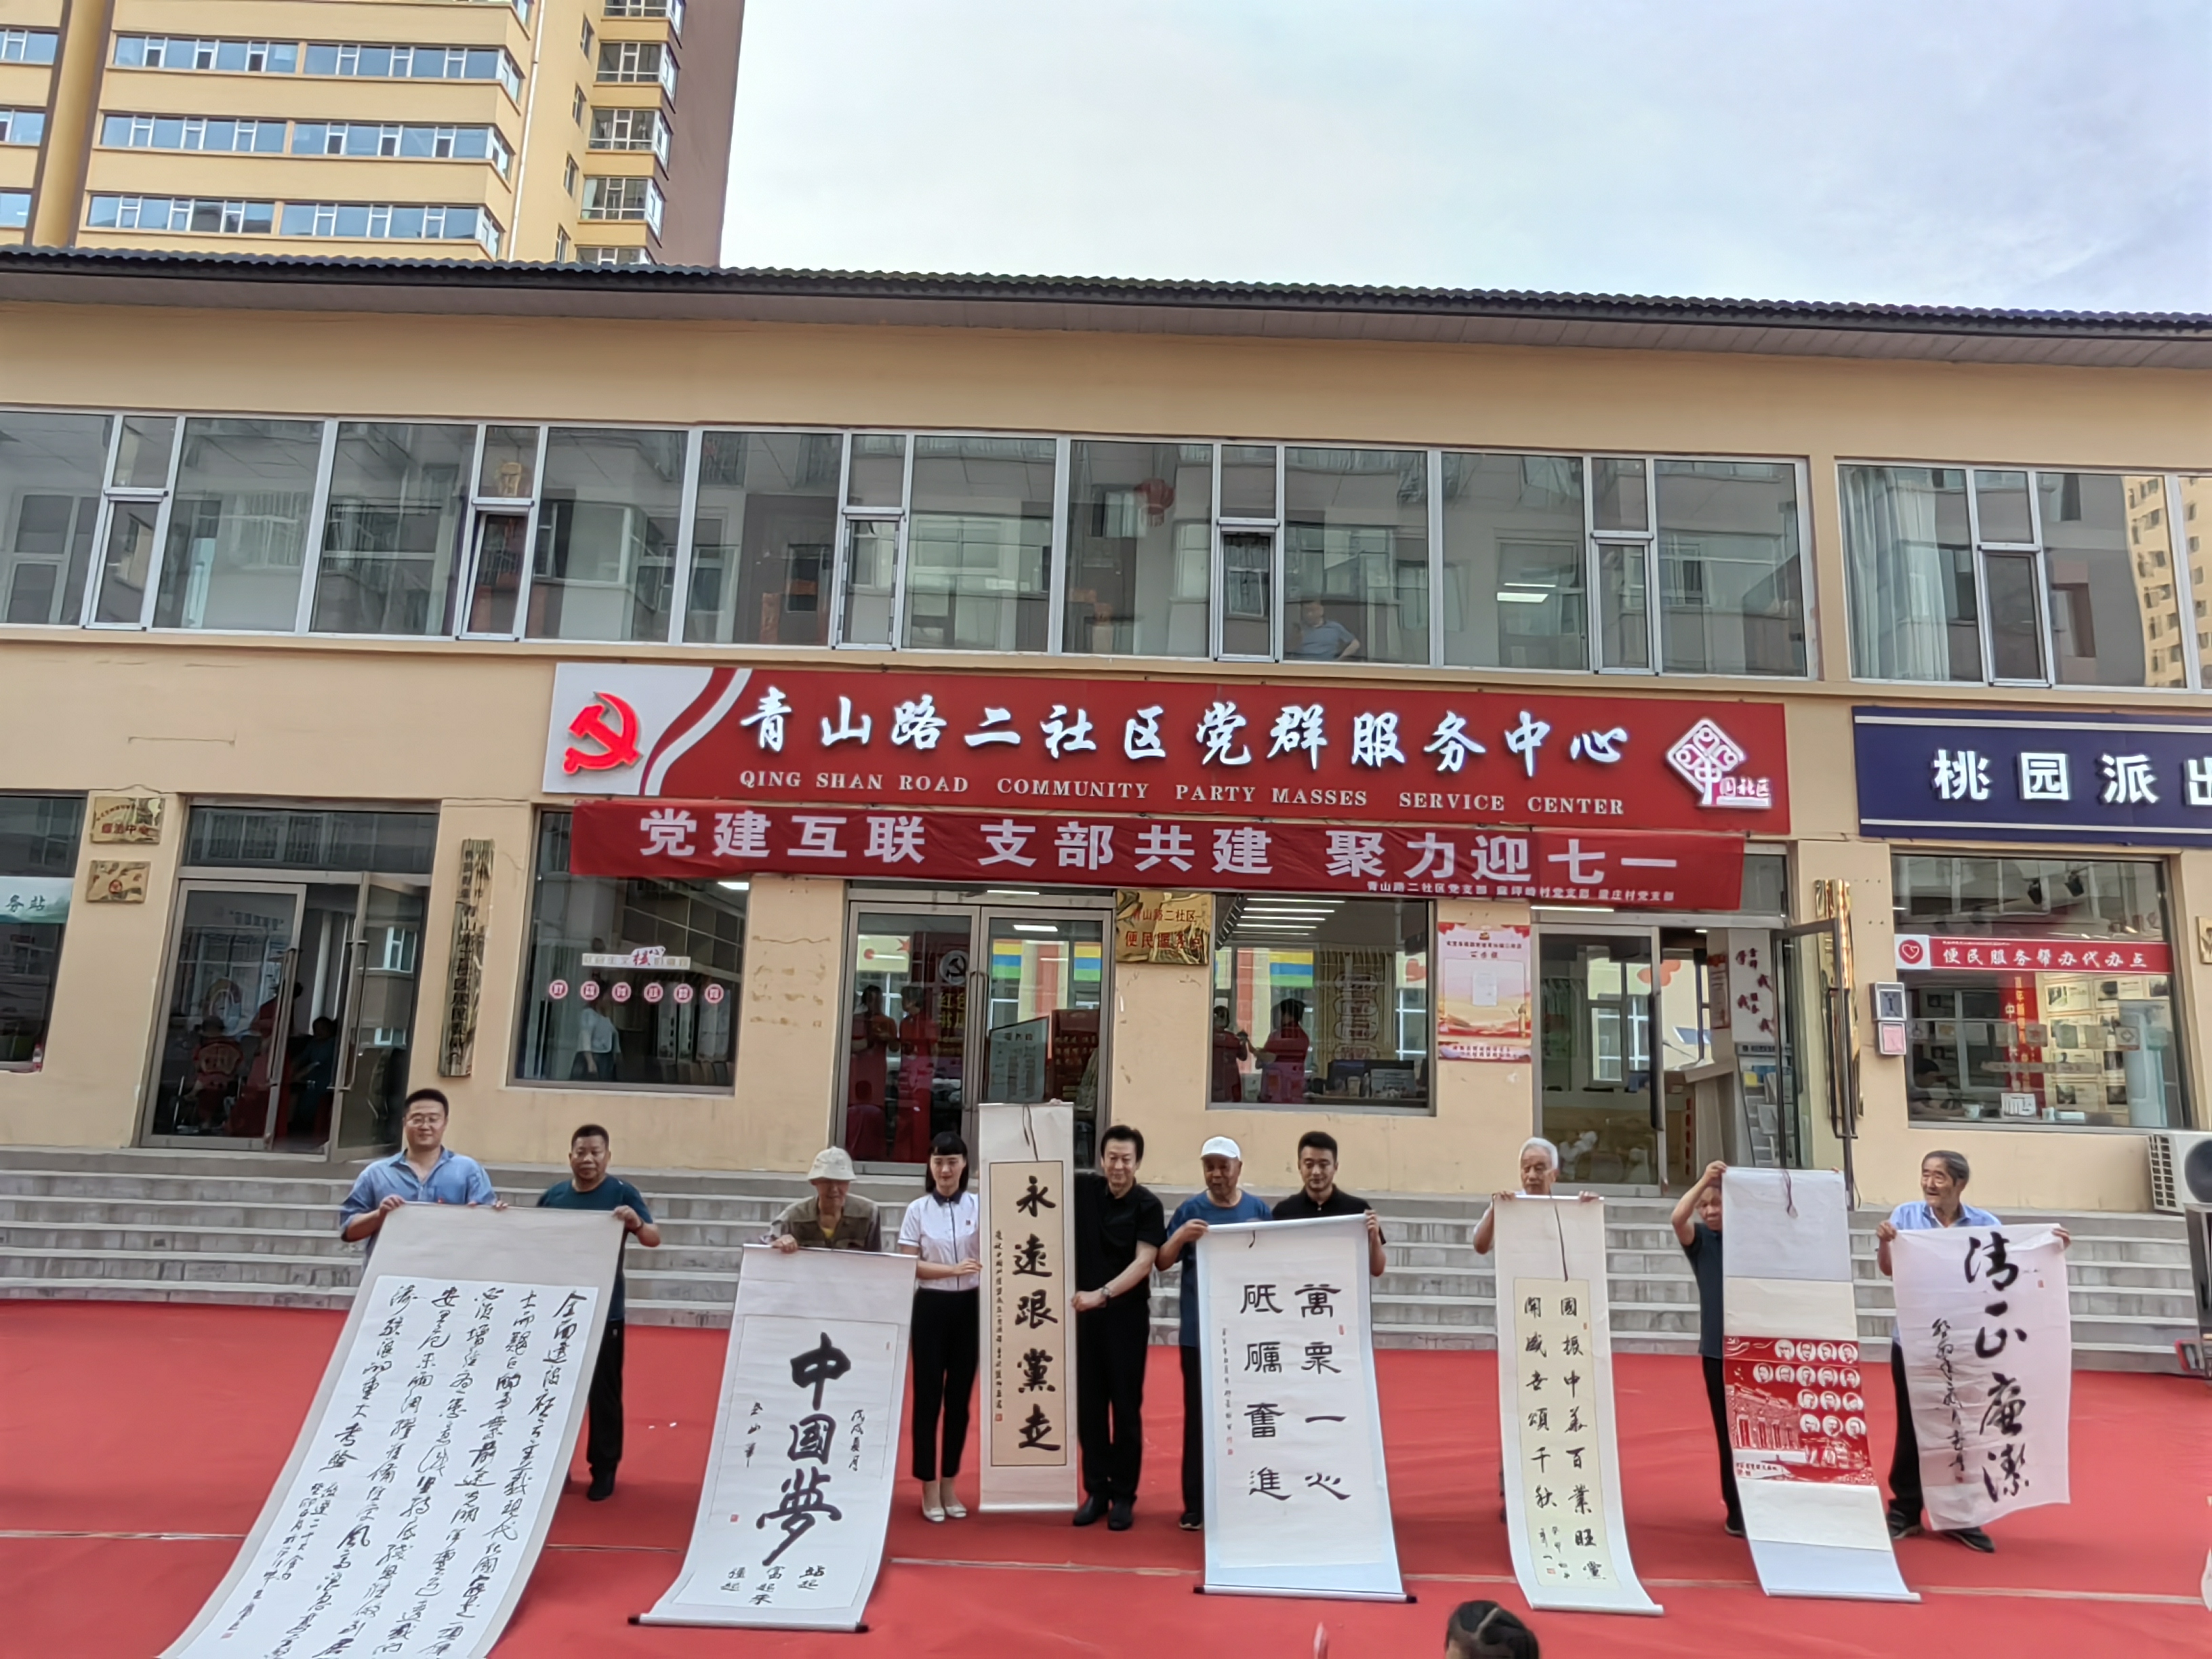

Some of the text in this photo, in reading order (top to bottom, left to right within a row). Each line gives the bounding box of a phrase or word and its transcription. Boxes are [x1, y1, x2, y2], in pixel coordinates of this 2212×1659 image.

[741, 686, 1629, 777] 青山路二社区党群服务中心
[739, 771, 1625, 816] QING SHAN ROAD COMMUNITY PARTY MASSES SERVICE CENTER
[639, 808, 1677, 886] 党建互联 支部共建 聚力迎七一
[5, 894, 45, 913] 务站
[1366, 880, 1488, 895] 青山路二社区党支部
[1942, 947, 2148, 968] 便民服务帮办代办点
